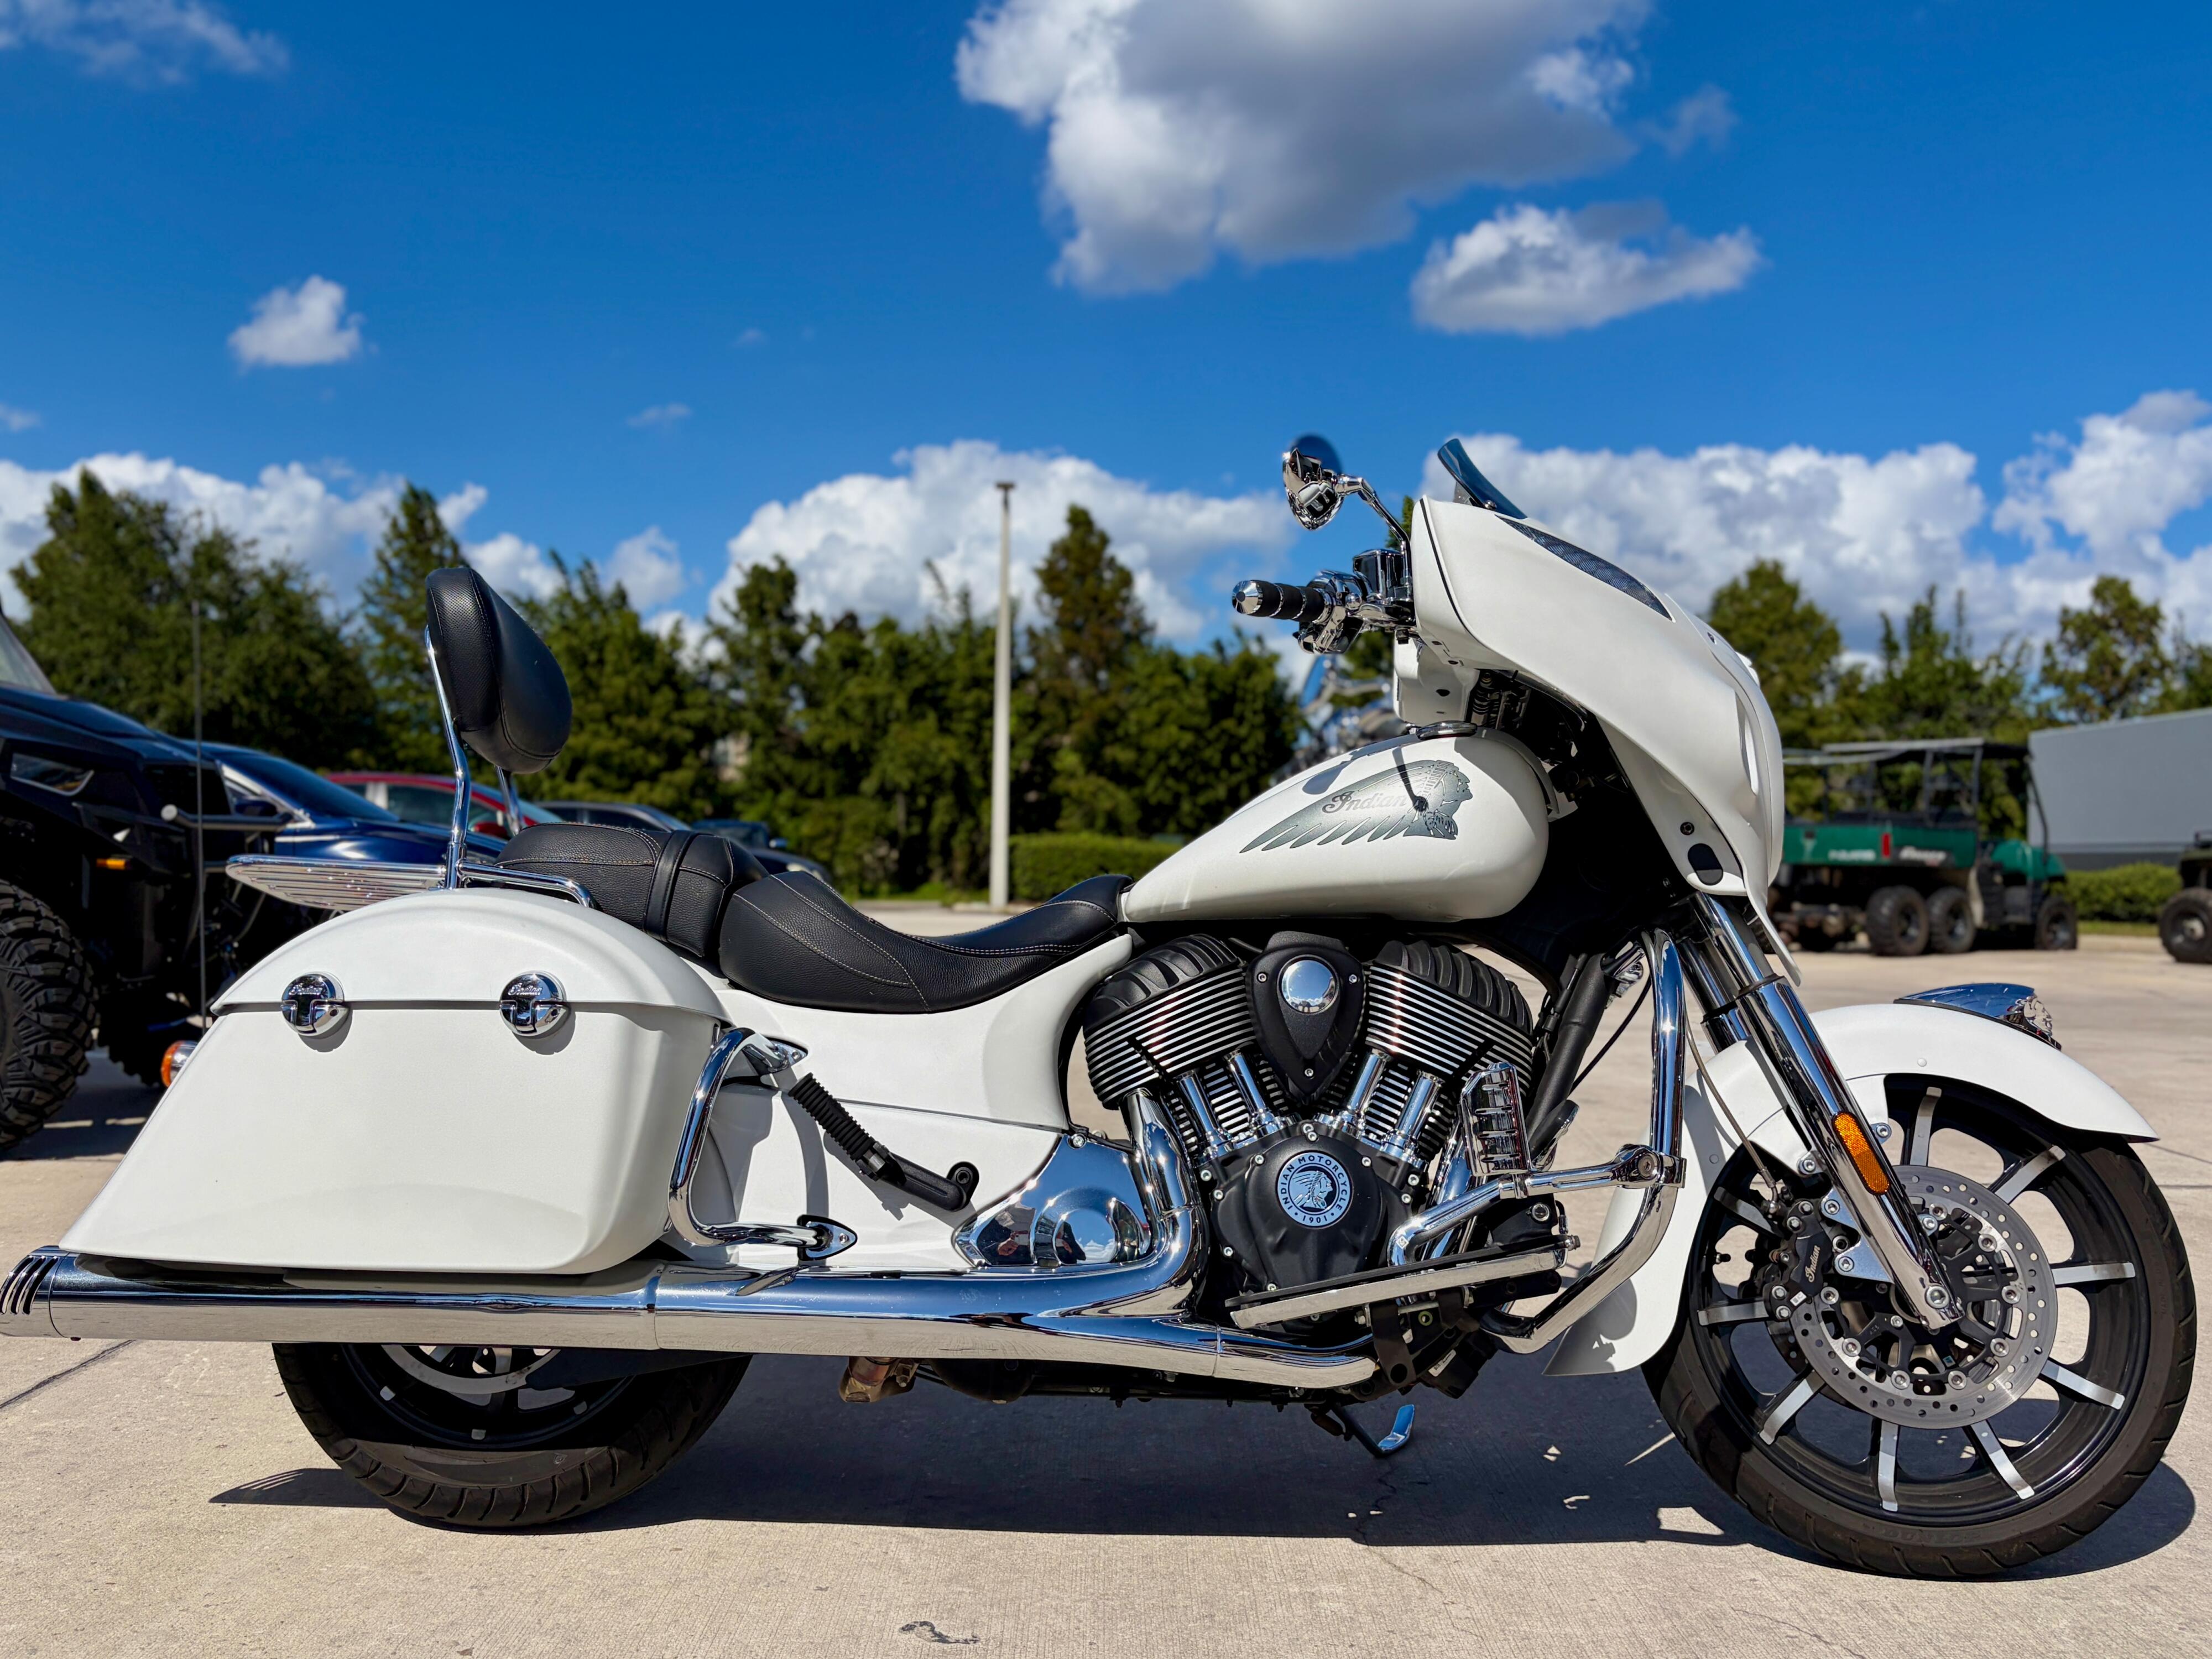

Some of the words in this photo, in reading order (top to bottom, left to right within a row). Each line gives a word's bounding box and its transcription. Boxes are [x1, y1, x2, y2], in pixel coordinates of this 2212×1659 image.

[1322, 790, 1407, 813] Indian
[1280, 1164, 1295, 1211] INDIAN
[1298, 1155, 1348, 1211] MOTORCYCLE
[1302, 1214, 1328, 1224] 1901
[1804, 1245, 1820, 1283] Indian
